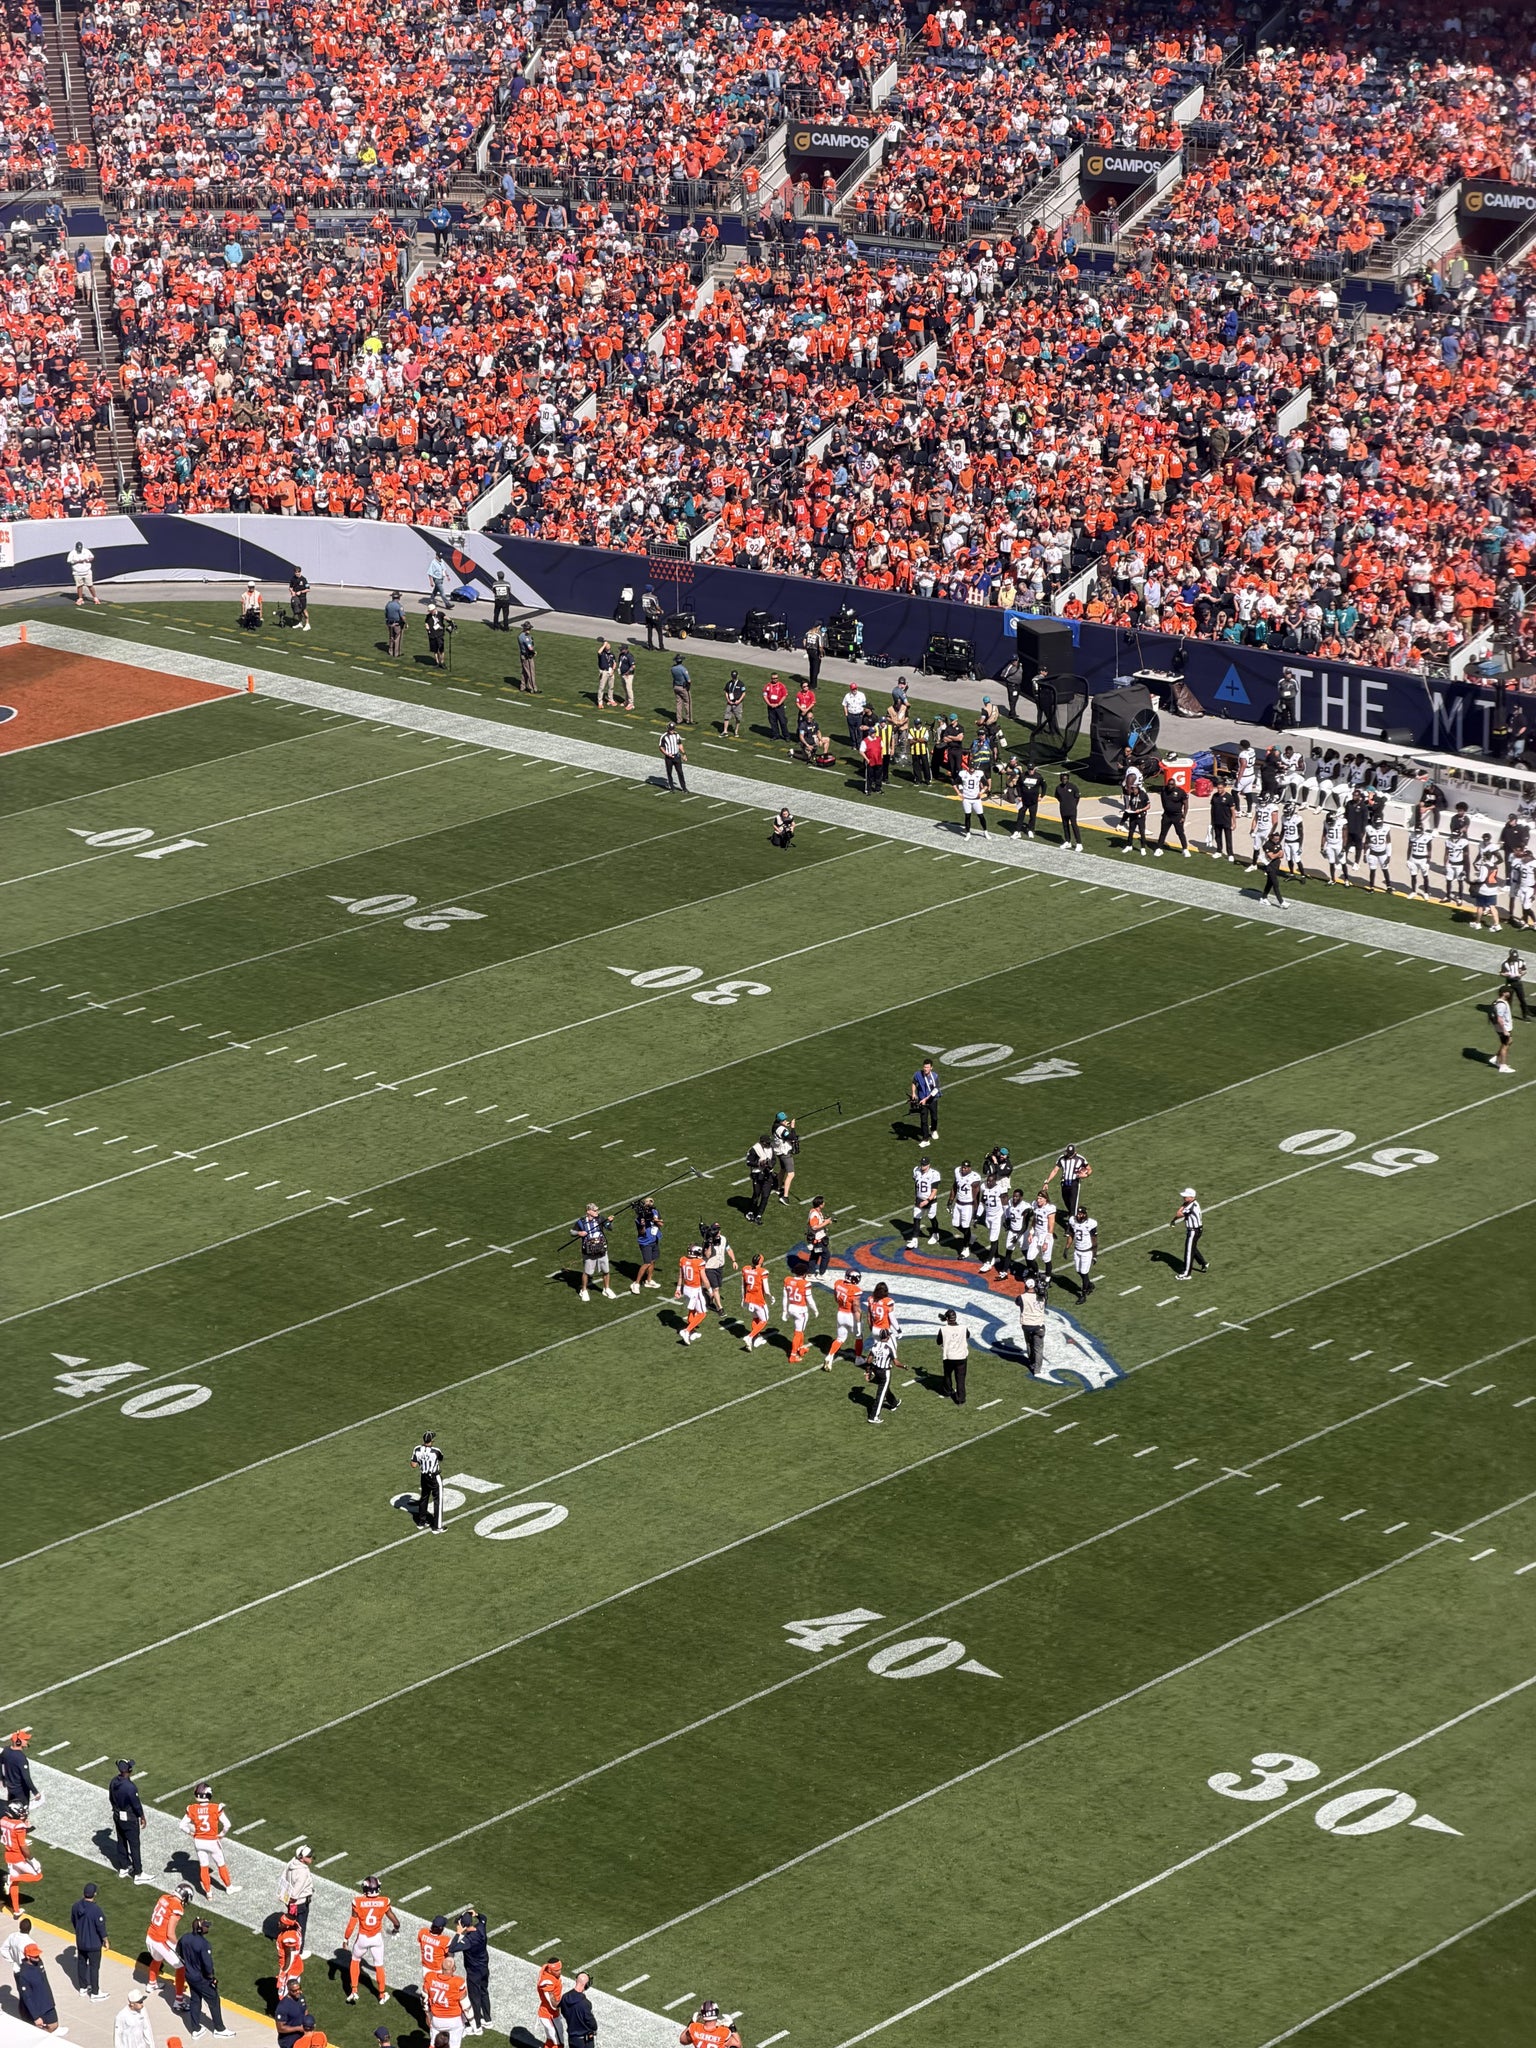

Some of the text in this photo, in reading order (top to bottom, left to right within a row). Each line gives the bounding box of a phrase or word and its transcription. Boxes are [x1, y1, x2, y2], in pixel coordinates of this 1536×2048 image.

[811, 132, 870, 149] CAMPOS
[1105, 157, 1162, 174] CAMPOS
[1484, 192, 1536, 210] CAMPO
[353, 300, 364, 309] 20
[751, 466, 759, 477] 7
[750, 544, 760, 552] 92
[1244, 600, 1251, 610] 2
[1340, 612, 1347, 623] 7
[1283, 666, 1388, 736] THE
[968, 779, 974, 790] 9
[1172, 771, 1186, 786] G
[1328, 829, 1338, 839] 51
[1370, 835, 1384, 845] 35
[85, 827, 208, 859] 10
[347, 893, 487, 931] 20
[630, 965, 772, 1005] 30
[938, 1042, 1083, 1084] 40
[1278, 1128, 1440, 1178] 50
[683, 1266, 693, 1281] 10
[746, 1276, 754, 1290] 9
[786, 1286, 801, 1302] 26
[53, 1361, 213, 1419] 40
[781, 1607, 967, 1679] 40
[1207, 1752, 1418, 1836] 30
[199, 1815, 210, 1832] 3
[367, 1908, 376, 1926] 6
[424, 1946, 434, 1962] 8
[430, 1988, 449, 2008] 74
